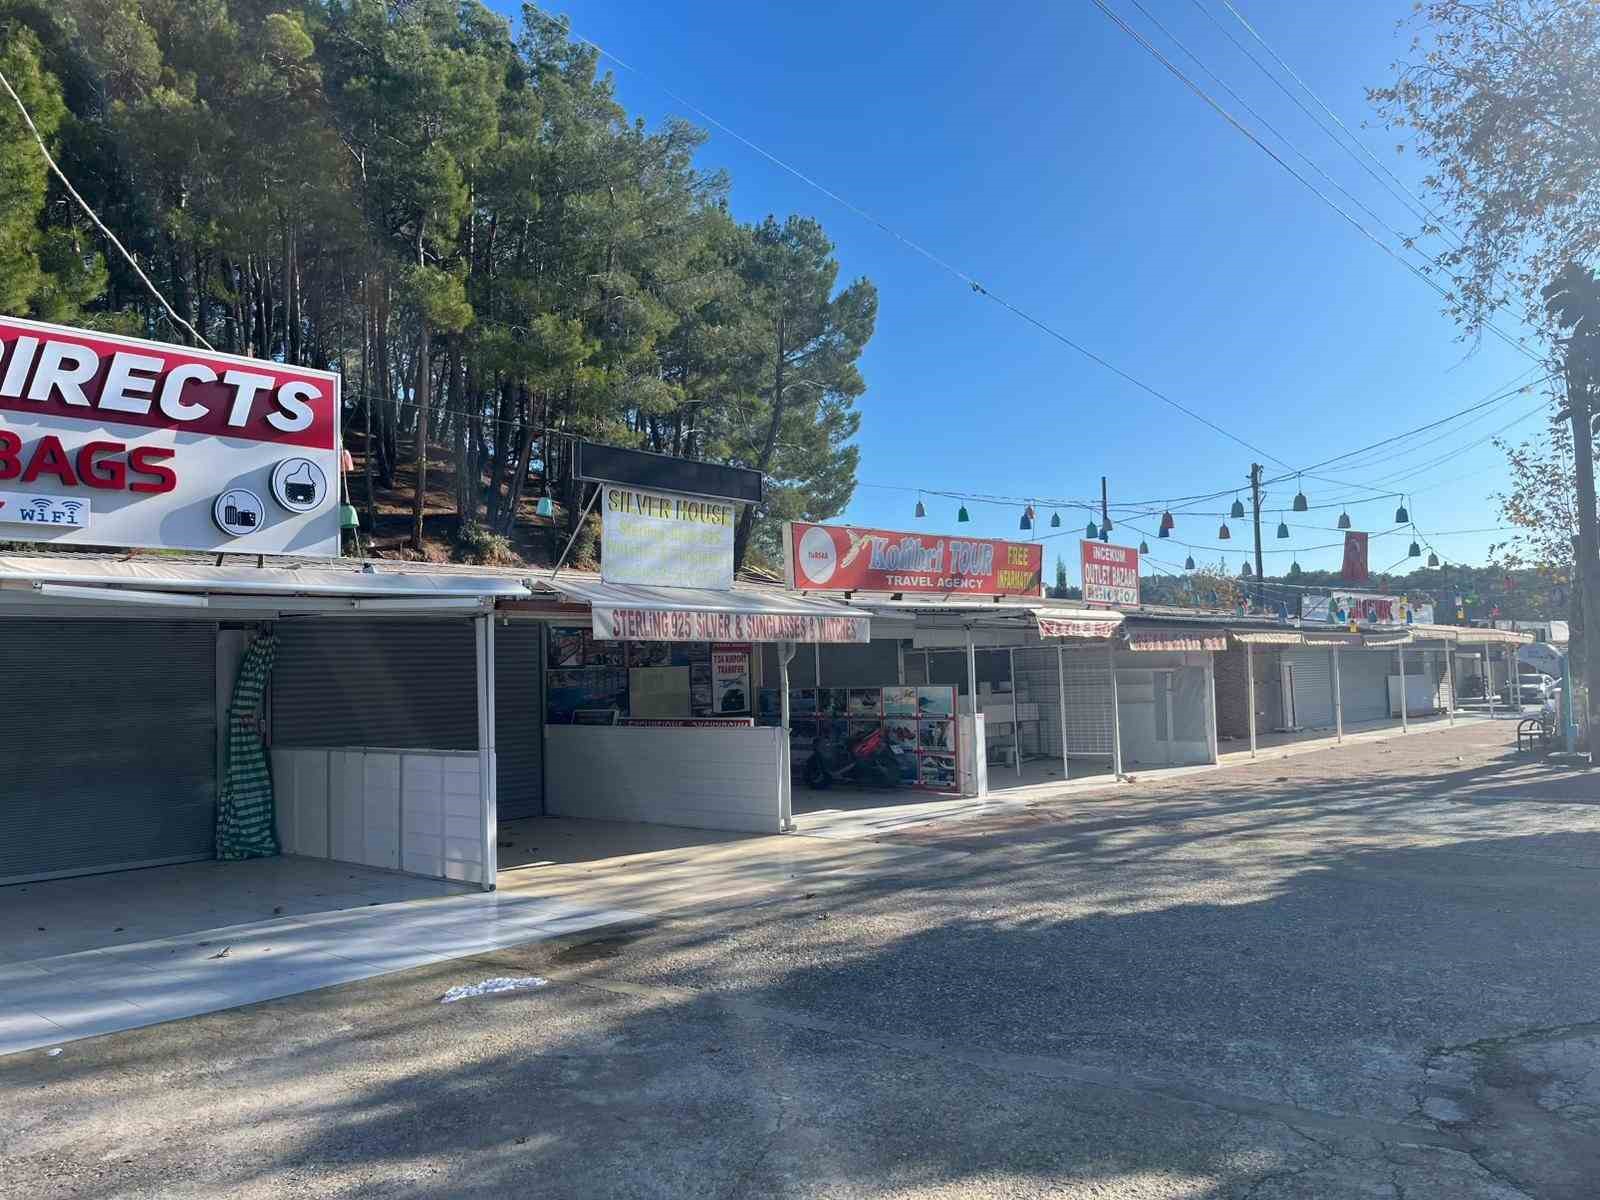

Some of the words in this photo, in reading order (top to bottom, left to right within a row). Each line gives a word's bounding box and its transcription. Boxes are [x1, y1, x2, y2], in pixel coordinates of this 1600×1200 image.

[0, 335, 322, 432] IRECTS
[20, 507, 79, 524] WiFi
[608, 489, 673, 519] SILVER
[676, 499, 731, 526] HOUSE
[949, 541, 994, 576] TOUR
[1007, 546, 1029, 566] FREE
[886, 575, 934, 588] TRAVEL
[937, 577, 984, 589] AGENCY
[1085, 563, 1110, 585] OUTLET
[1112, 566, 1137, 588] BAZAAR
[671, 610, 692, 638] 925
[746, 615, 807, 640] SUNGLASSES
